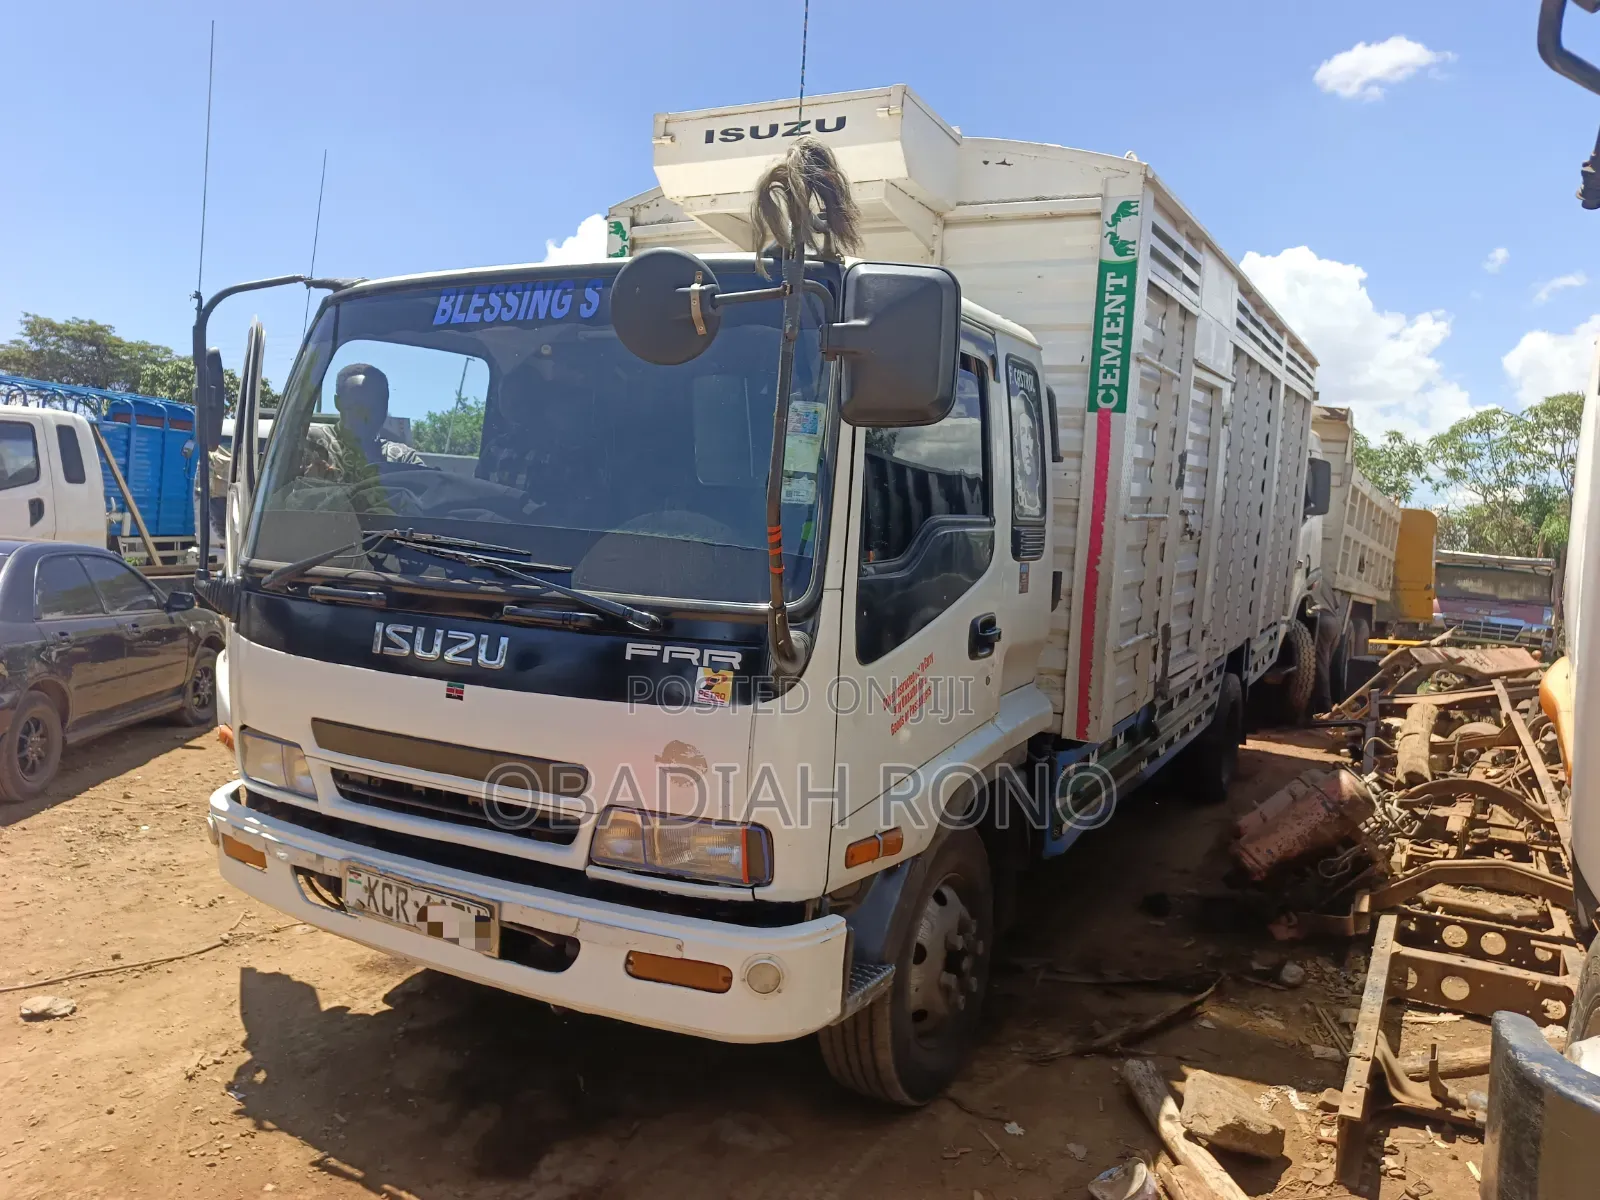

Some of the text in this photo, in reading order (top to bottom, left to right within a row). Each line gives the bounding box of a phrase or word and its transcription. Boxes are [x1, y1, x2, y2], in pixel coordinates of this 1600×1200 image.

[705, 116, 846, 144] ISUZU
[433, 280, 575, 325] BLESSING
[1097, 272, 1127, 409] CEMENT
[372, 622, 509, 669] ISUZU
[625, 643, 742, 670] FRR
[698, 689, 726, 700] PETRO
[367, 877, 409, 923] KCR
